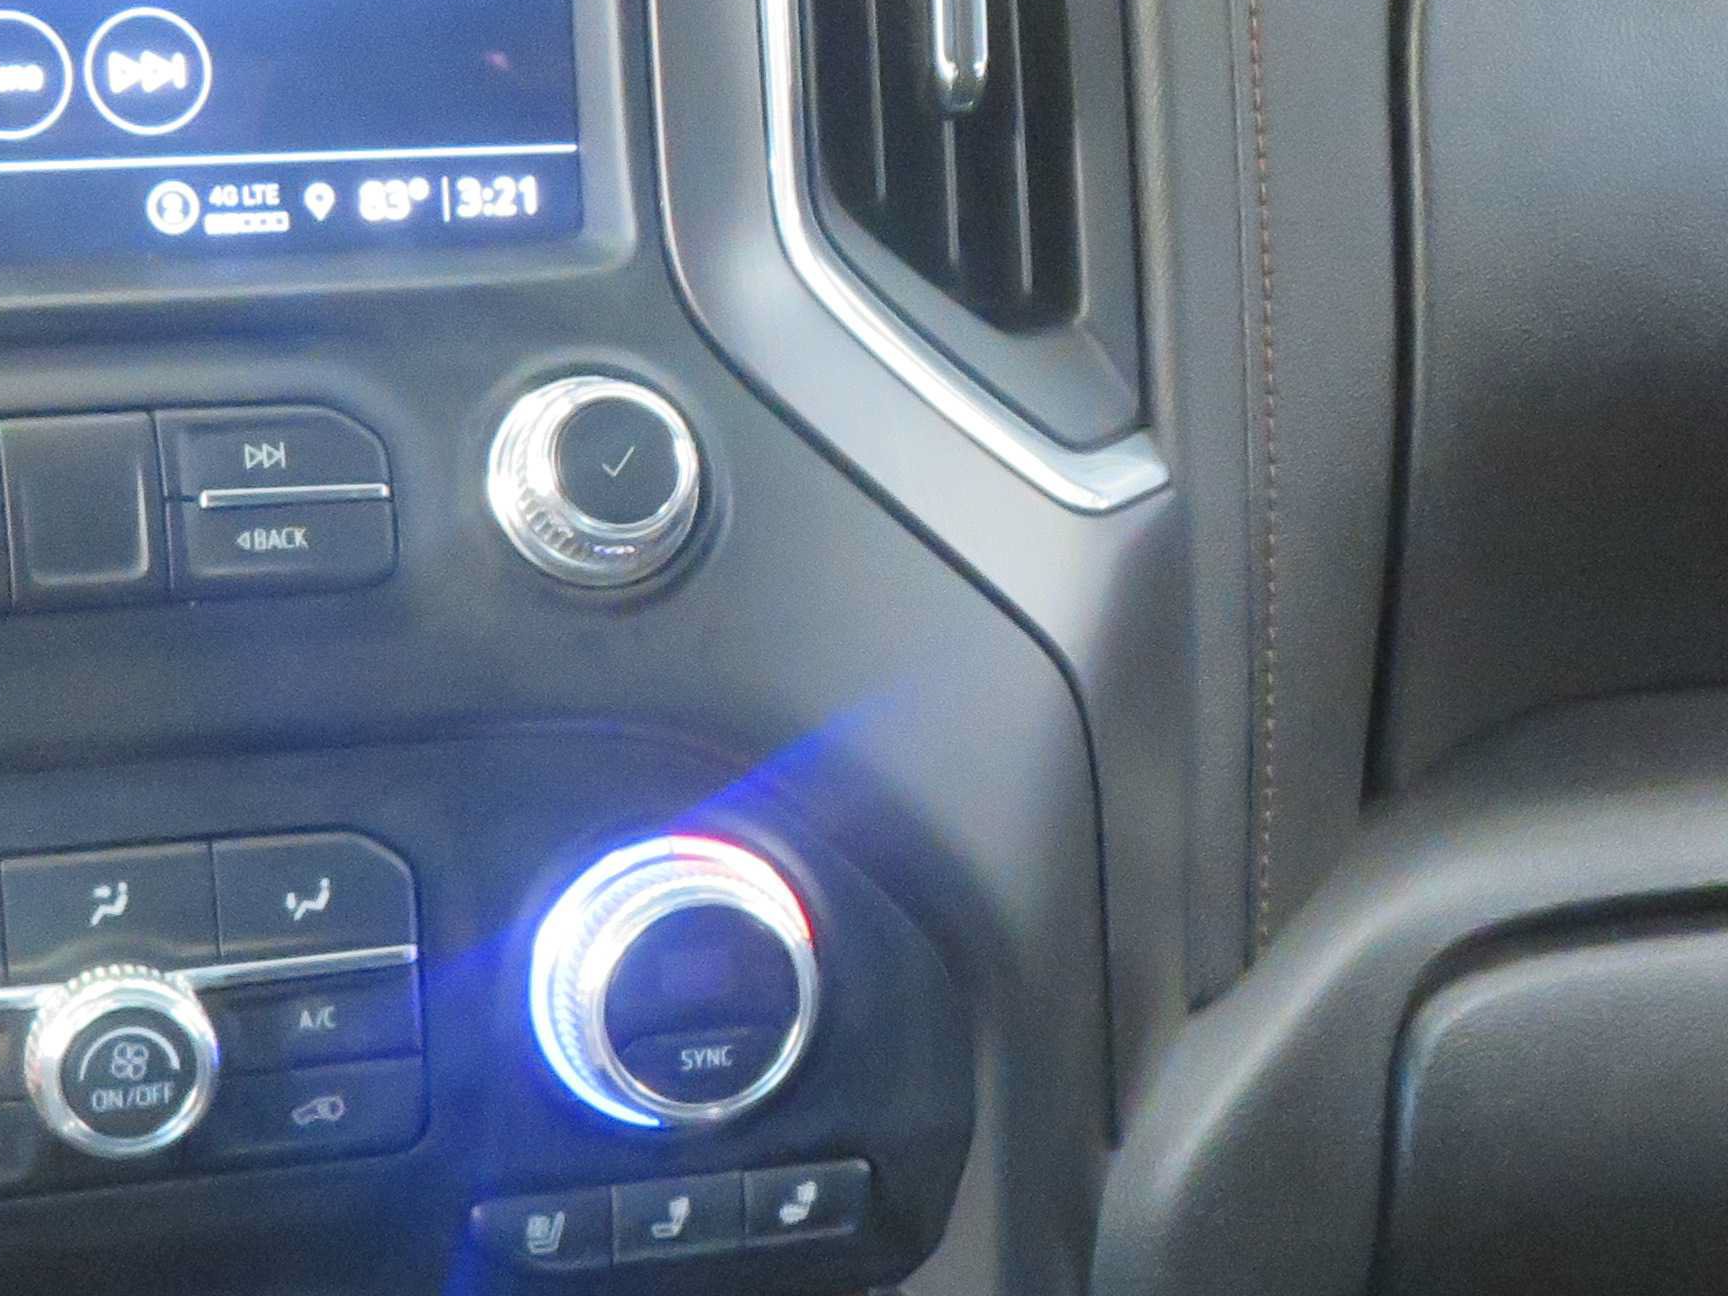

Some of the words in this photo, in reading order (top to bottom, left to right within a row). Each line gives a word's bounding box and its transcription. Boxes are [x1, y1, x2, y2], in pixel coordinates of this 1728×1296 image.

[208, 184, 239, 207] 4G
[242, 182, 280, 207] LTE
[456, 175, 539, 220] 3:21
[252, 526, 309, 551] BACK
[299, 1006, 336, 1030] A/C
[681, 1045, 733, 1071] SYNC
[91, 1081, 175, 1112] ON/OFF
